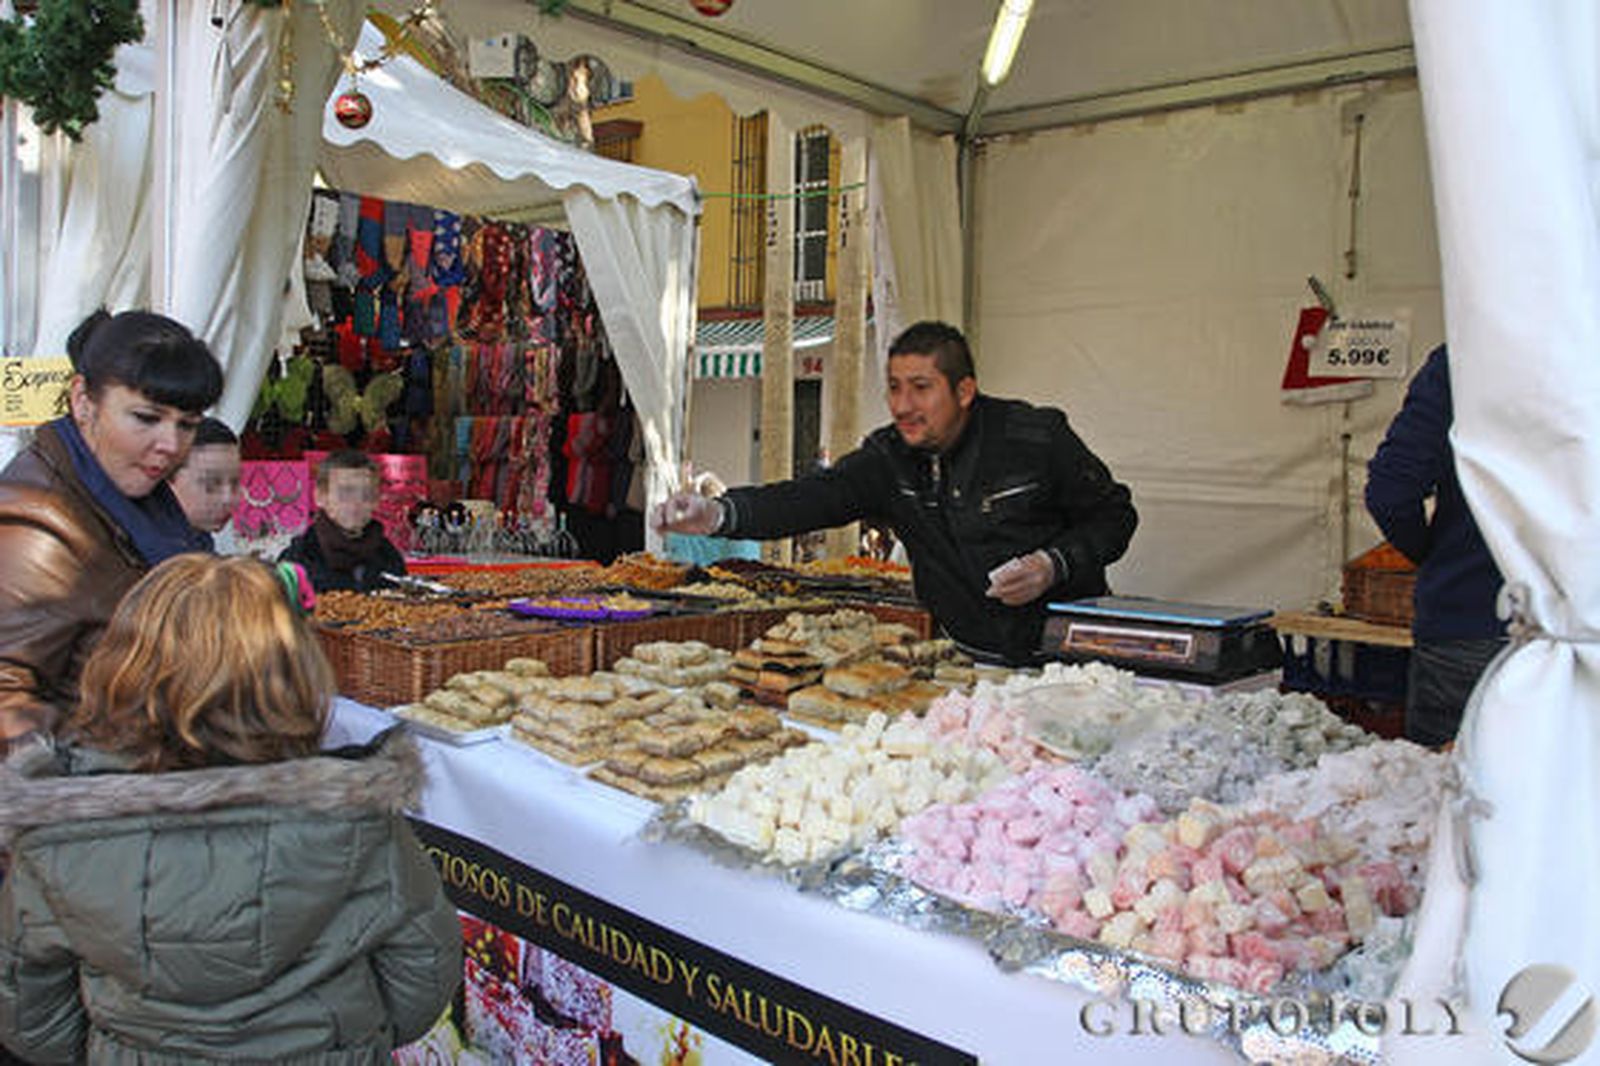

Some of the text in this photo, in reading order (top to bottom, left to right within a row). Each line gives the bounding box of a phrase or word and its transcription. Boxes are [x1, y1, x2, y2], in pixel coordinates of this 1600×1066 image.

[1328, 348, 1390, 366] 5.99€
[419, 845, 918, 1066] IOSOS DE CALIDAD Y SALUDABL
